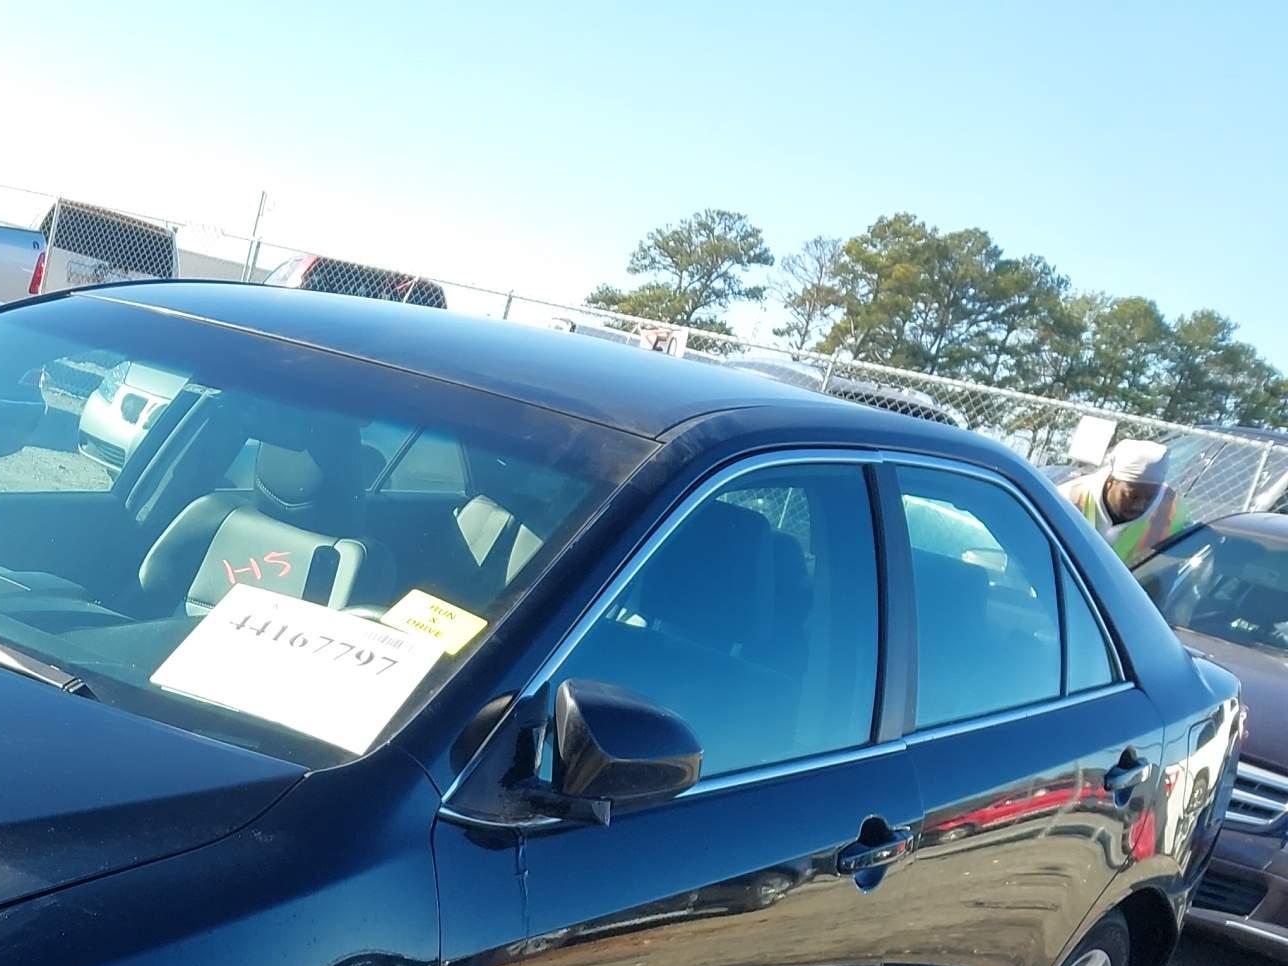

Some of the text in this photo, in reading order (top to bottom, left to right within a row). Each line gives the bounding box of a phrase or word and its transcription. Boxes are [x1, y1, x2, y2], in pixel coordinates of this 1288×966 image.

[430, 604, 457, 621] RUN
[406, 618, 443, 639] DRIVE
[229, 614, 399, 676] 44167797
